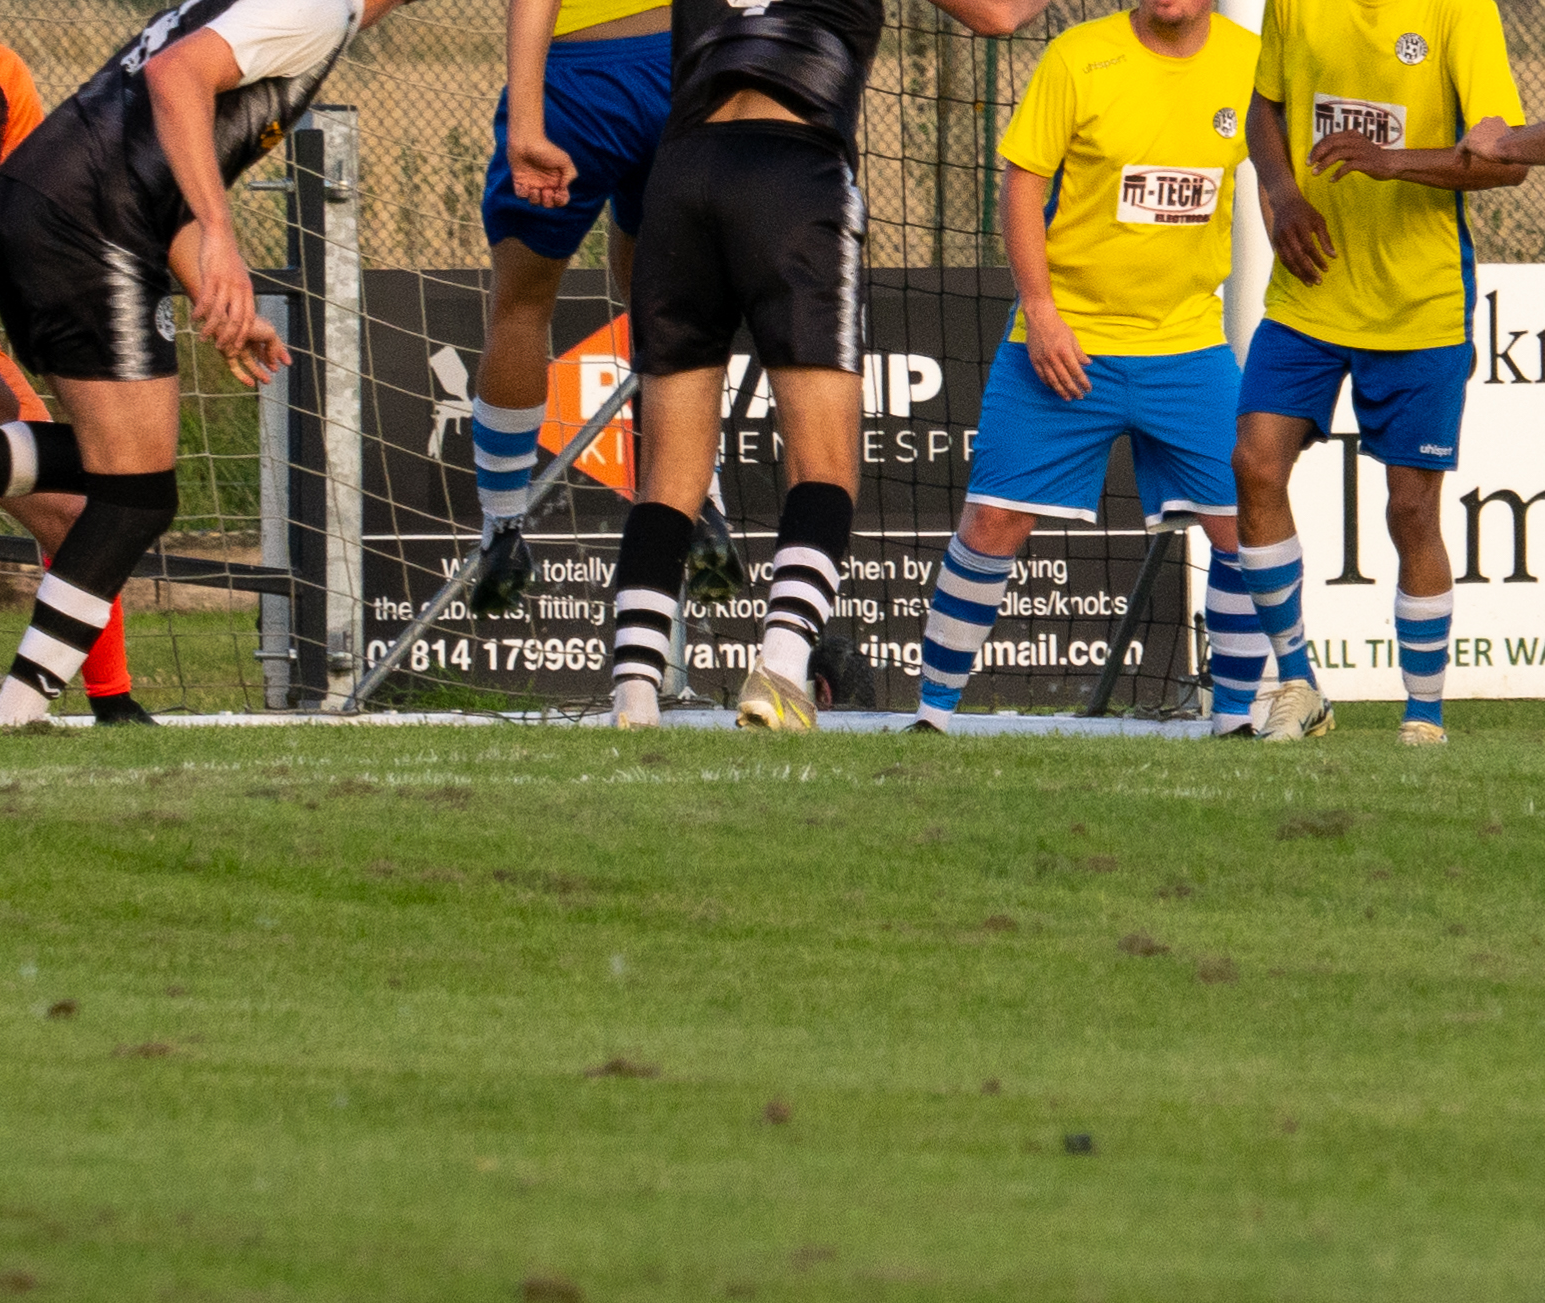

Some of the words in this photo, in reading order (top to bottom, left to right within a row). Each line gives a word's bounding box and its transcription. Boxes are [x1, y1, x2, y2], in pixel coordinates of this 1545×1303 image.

[543, 558, 616, 587] totally
[903, 556, 932, 585] by
[374, 597, 414, 620] the
[539, 595, 605, 625] fitting
[367, 638, 472, 672] 0814
[484, 638, 606, 672] 179969
